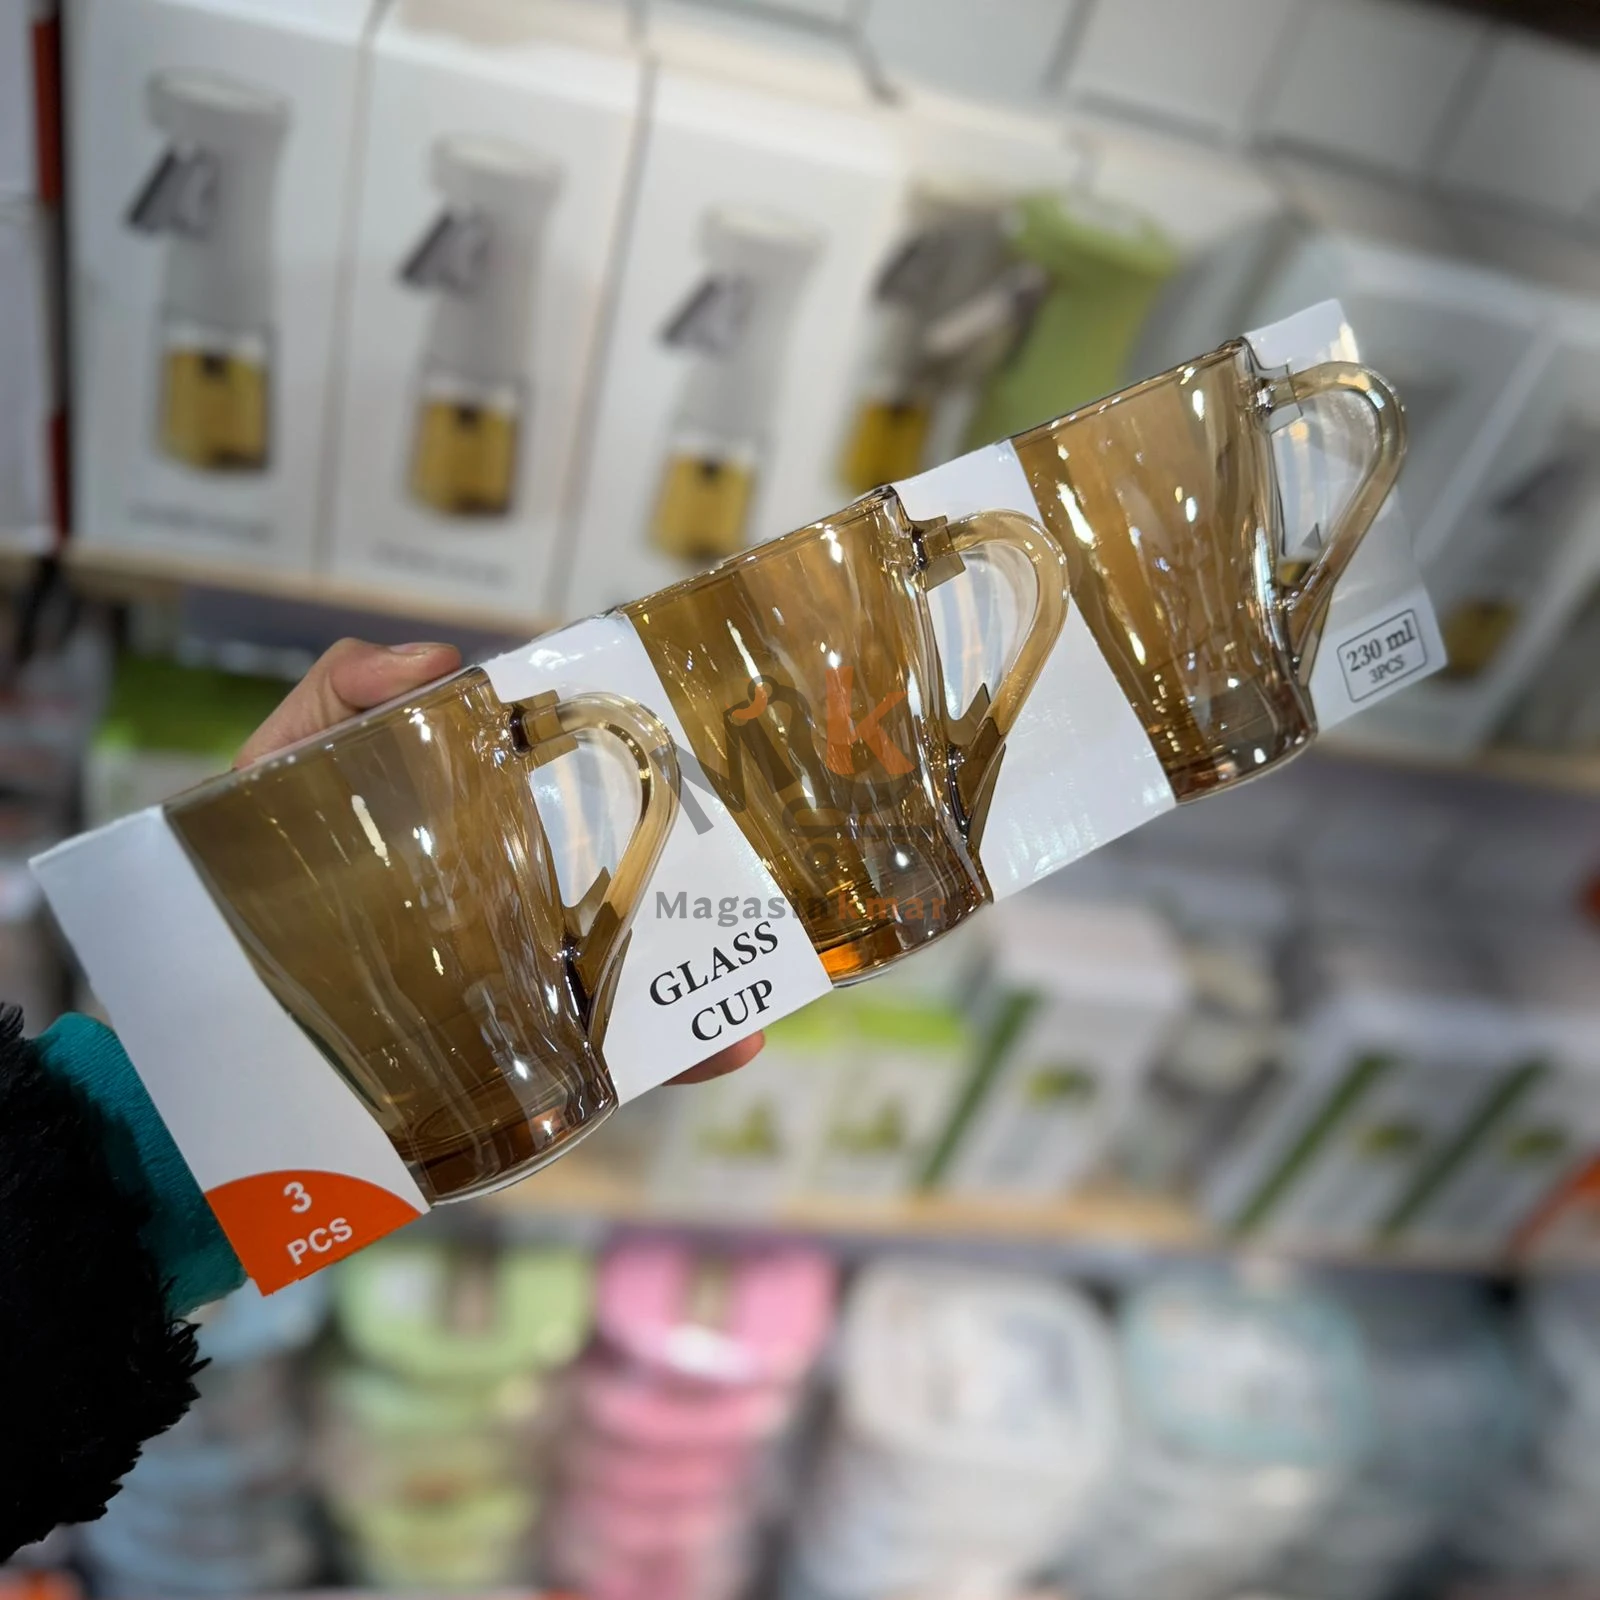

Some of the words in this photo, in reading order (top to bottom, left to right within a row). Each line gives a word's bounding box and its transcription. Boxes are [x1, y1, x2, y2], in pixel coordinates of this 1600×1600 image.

[1347, 639, 1382, 672] 230
[1386, 619, 1415, 651] ml
[1369, 654, 1404, 684] 3PCS
[649, 920, 778, 1006] GLASS
[691, 979, 773, 1041] CUP
[284, 1182, 312, 1213] 3
[287, 1217, 353, 1265] PCS
